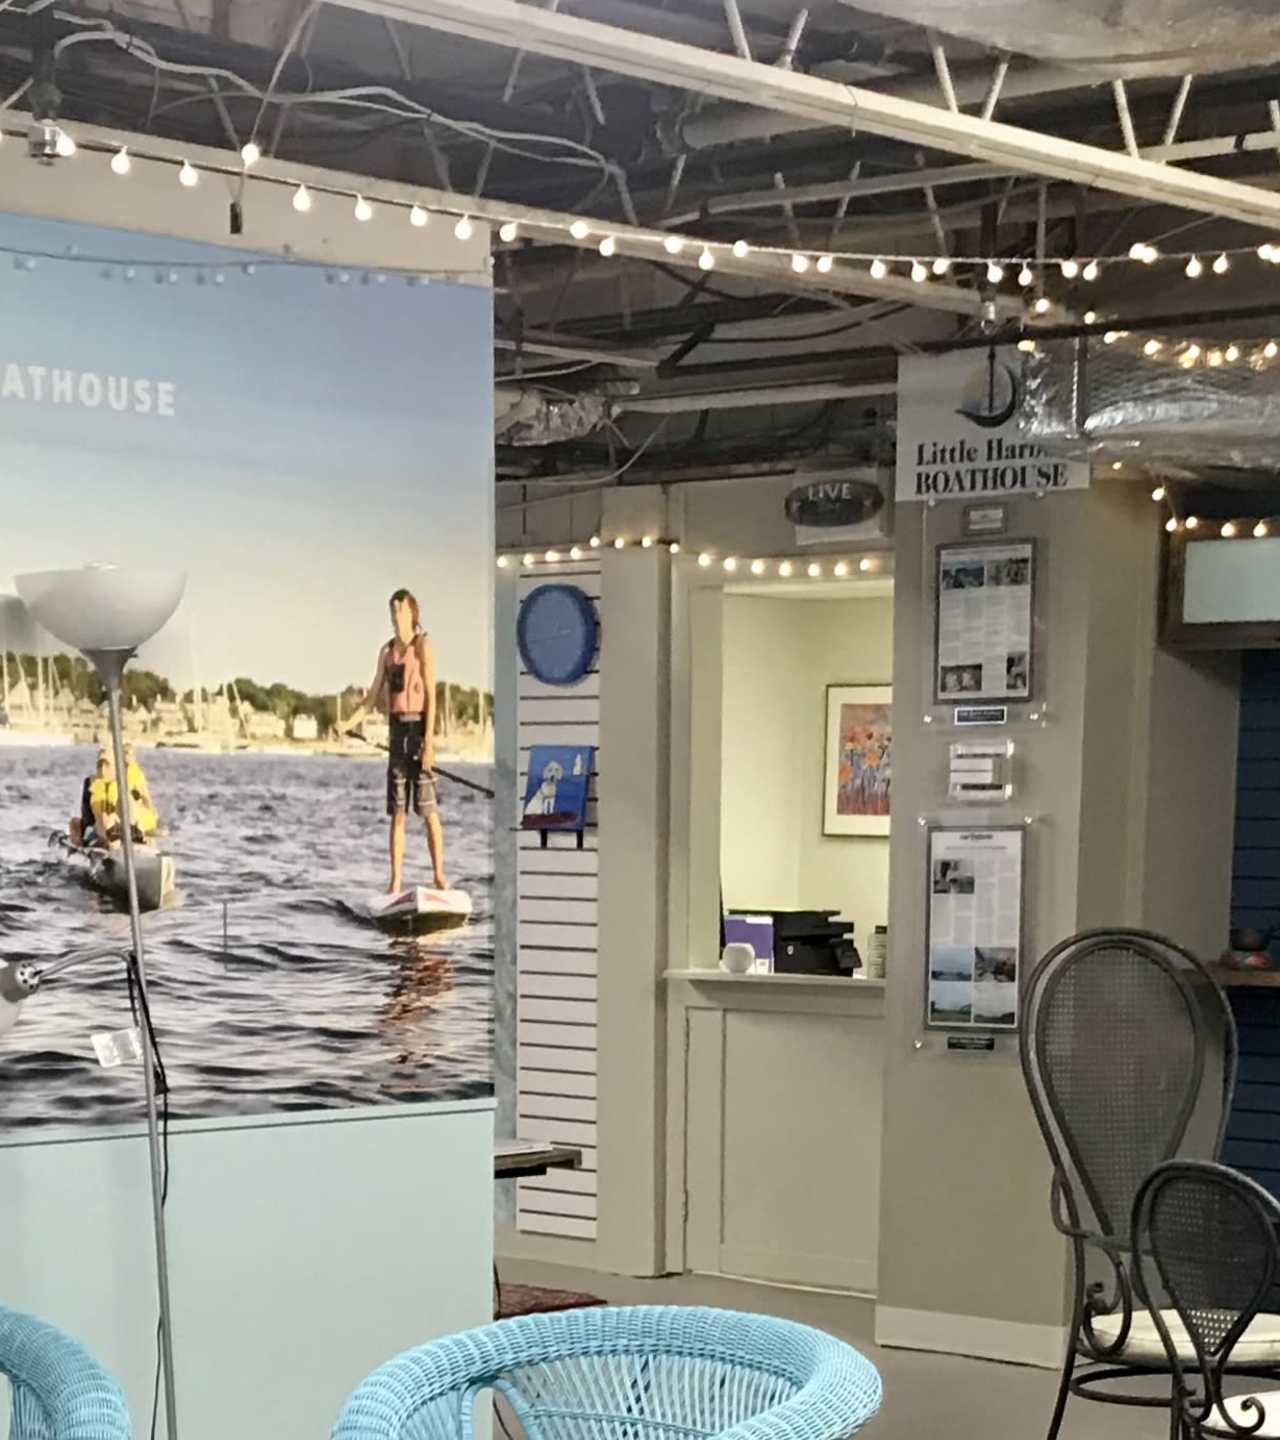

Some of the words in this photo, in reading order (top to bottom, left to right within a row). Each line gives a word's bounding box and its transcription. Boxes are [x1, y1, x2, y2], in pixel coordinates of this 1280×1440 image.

[916, 438, 978, 466] Little
[807, 482, 852, 501] LIVE
[915, 462, 1069, 495] BOATHOUSE
